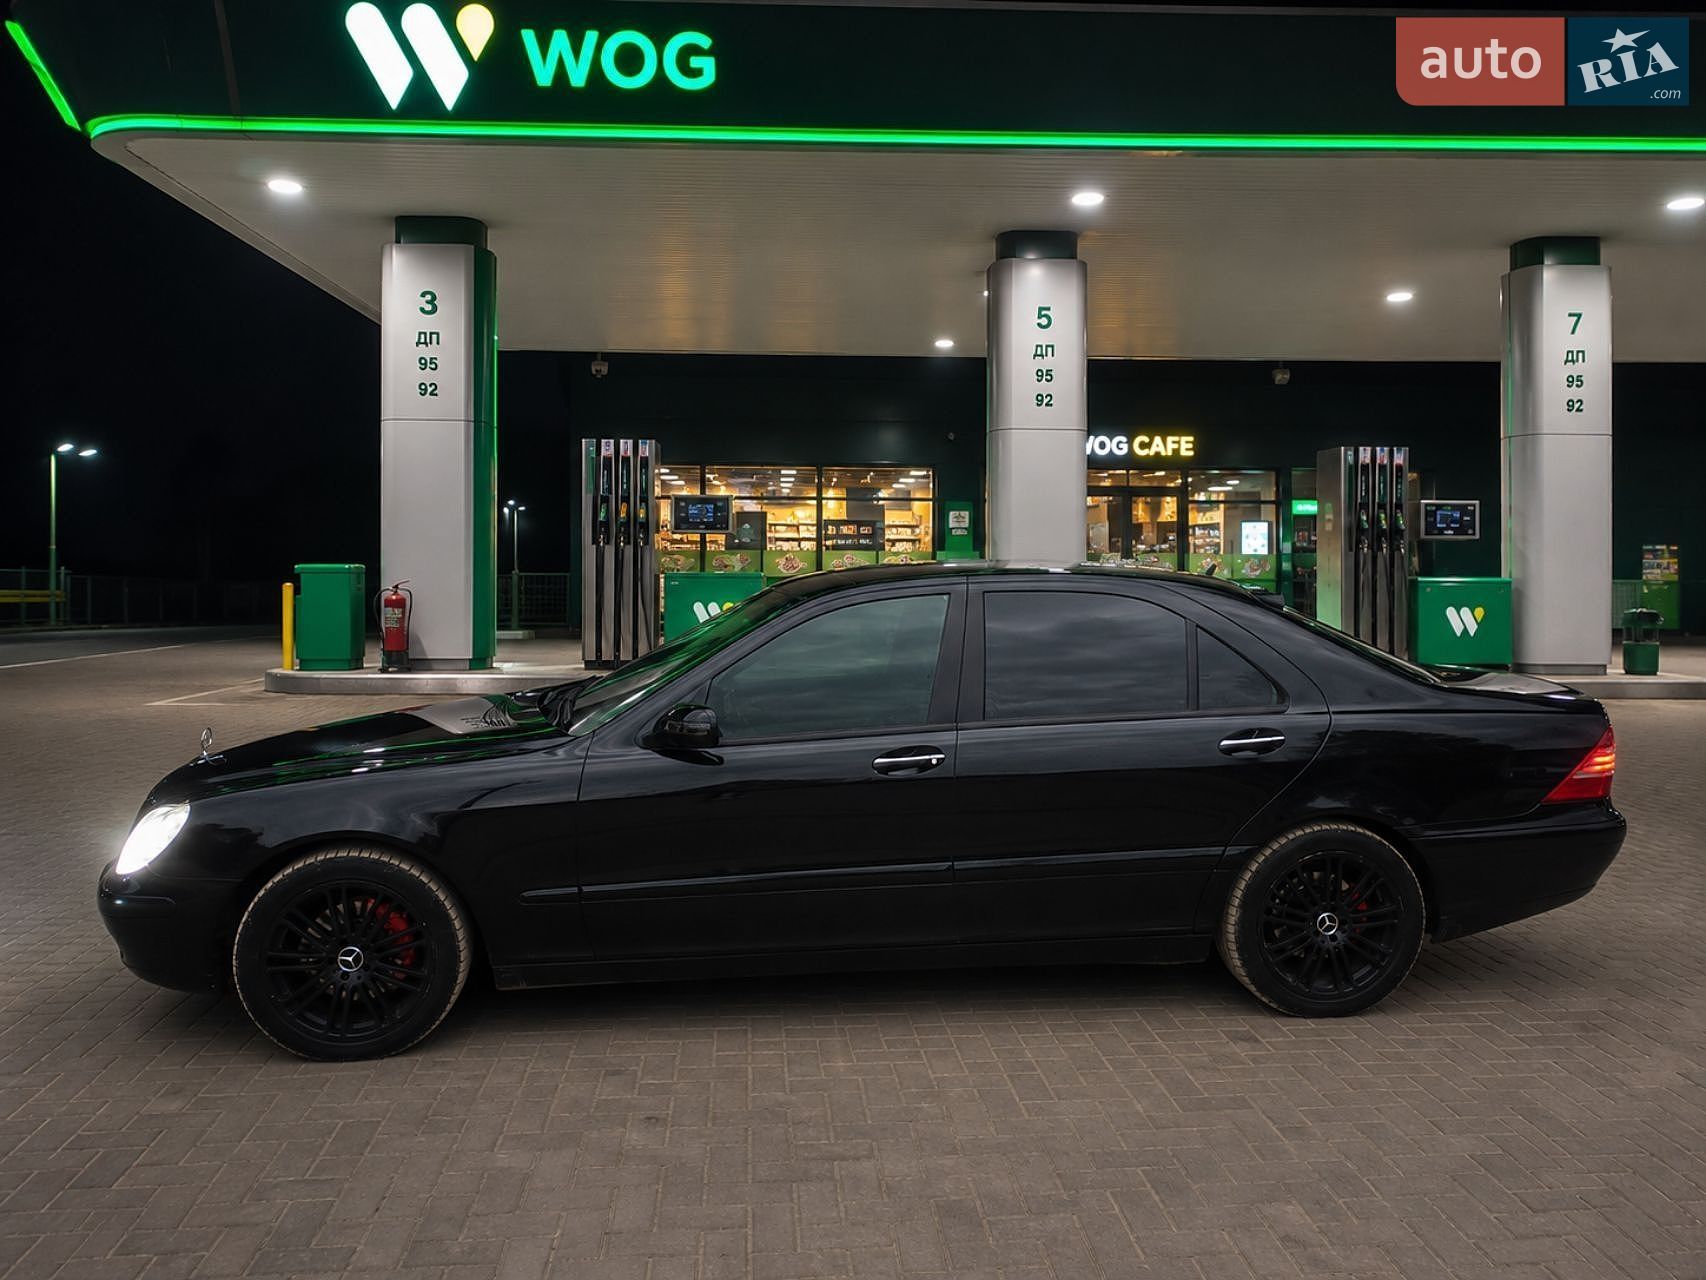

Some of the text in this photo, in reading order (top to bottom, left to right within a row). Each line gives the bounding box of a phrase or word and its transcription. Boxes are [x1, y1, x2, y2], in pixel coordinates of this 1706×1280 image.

[520, 28, 716, 91] WOG
[418, 290, 438, 316] 3
[1036, 306, 1053, 330] 5
[1567, 312, 1583, 335] 7
[415, 331, 440, 347] ДП
[1032, 344, 1055, 360] ДП
[1564, 349, 1586, 366] ДП
[418, 356, 438, 371] 95
[1035, 368, 1054, 383] 95
[1566, 374, 1584, 388] 95
[418, 382, 438, 397] 92
[1035, 393, 1054, 407] 92
[1566, 399, 1584, 413] 92
[1133, 435, 1194, 456] CAFE
